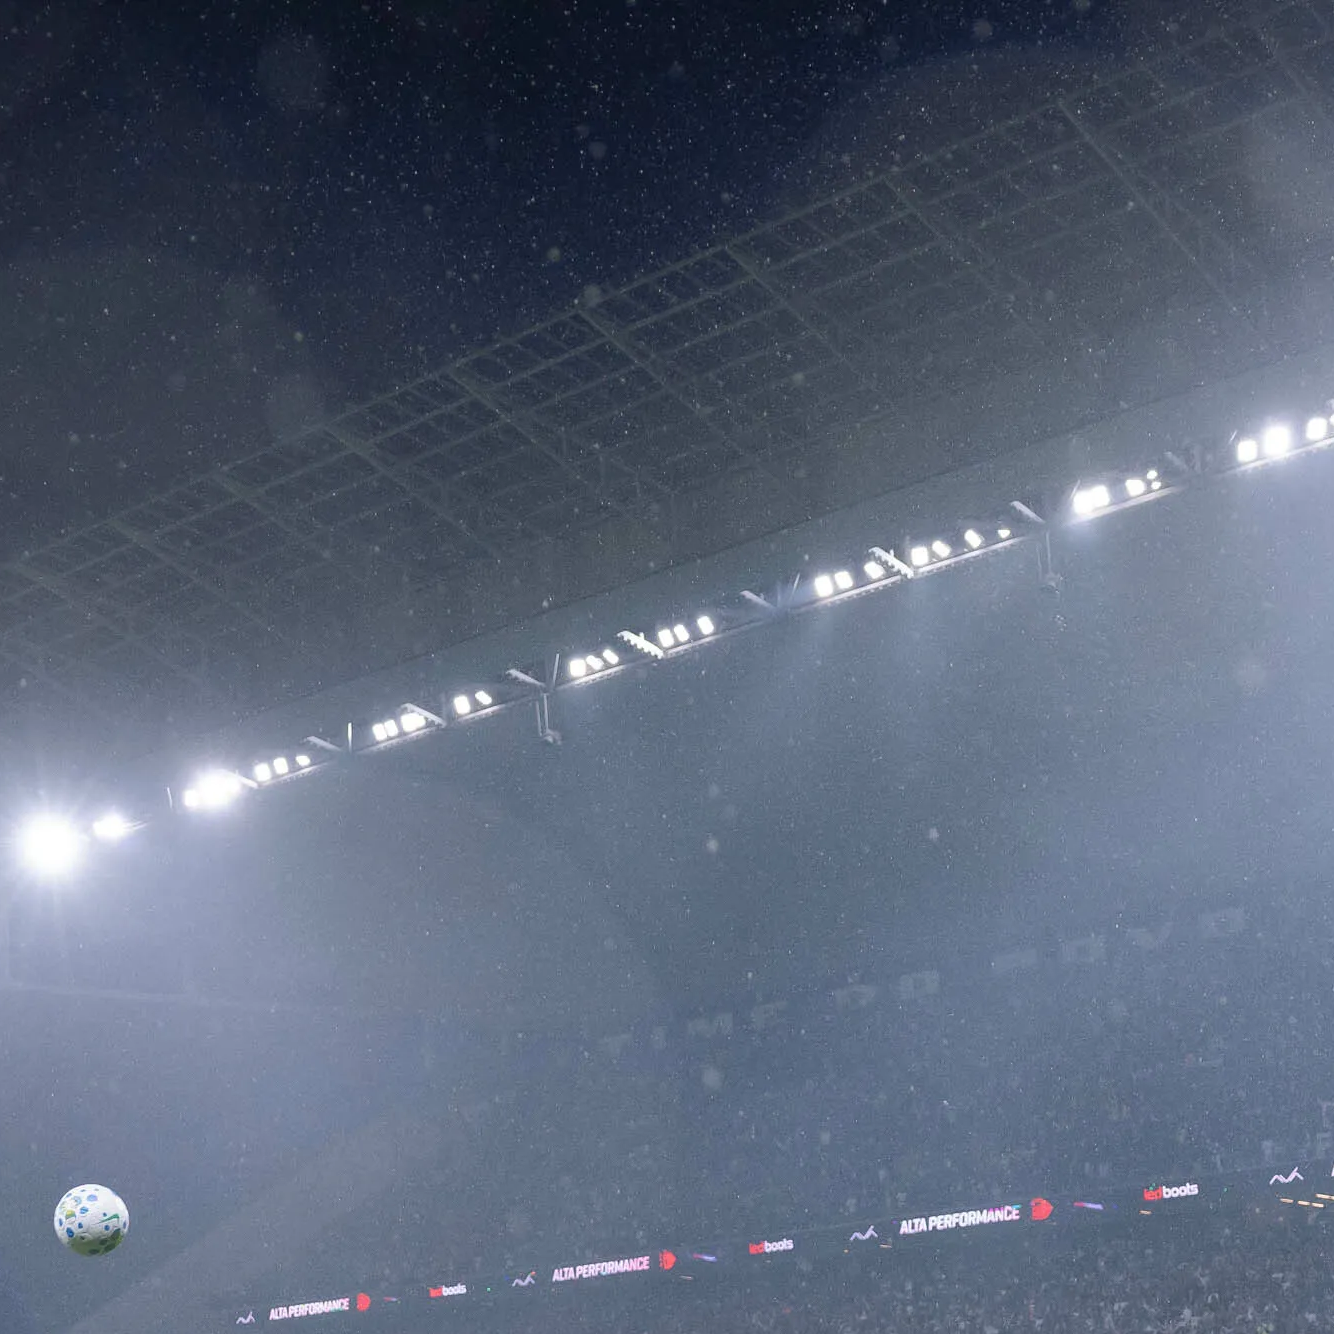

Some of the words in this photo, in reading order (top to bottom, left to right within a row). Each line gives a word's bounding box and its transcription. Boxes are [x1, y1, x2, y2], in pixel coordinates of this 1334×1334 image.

[899, 1217, 927, 1235] ALTA
[927, 1204, 1021, 1232] PERFORMANCE
[552, 1266, 576, 1282] ALTA
[575, 1255, 651, 1280] PERFORMANCE
